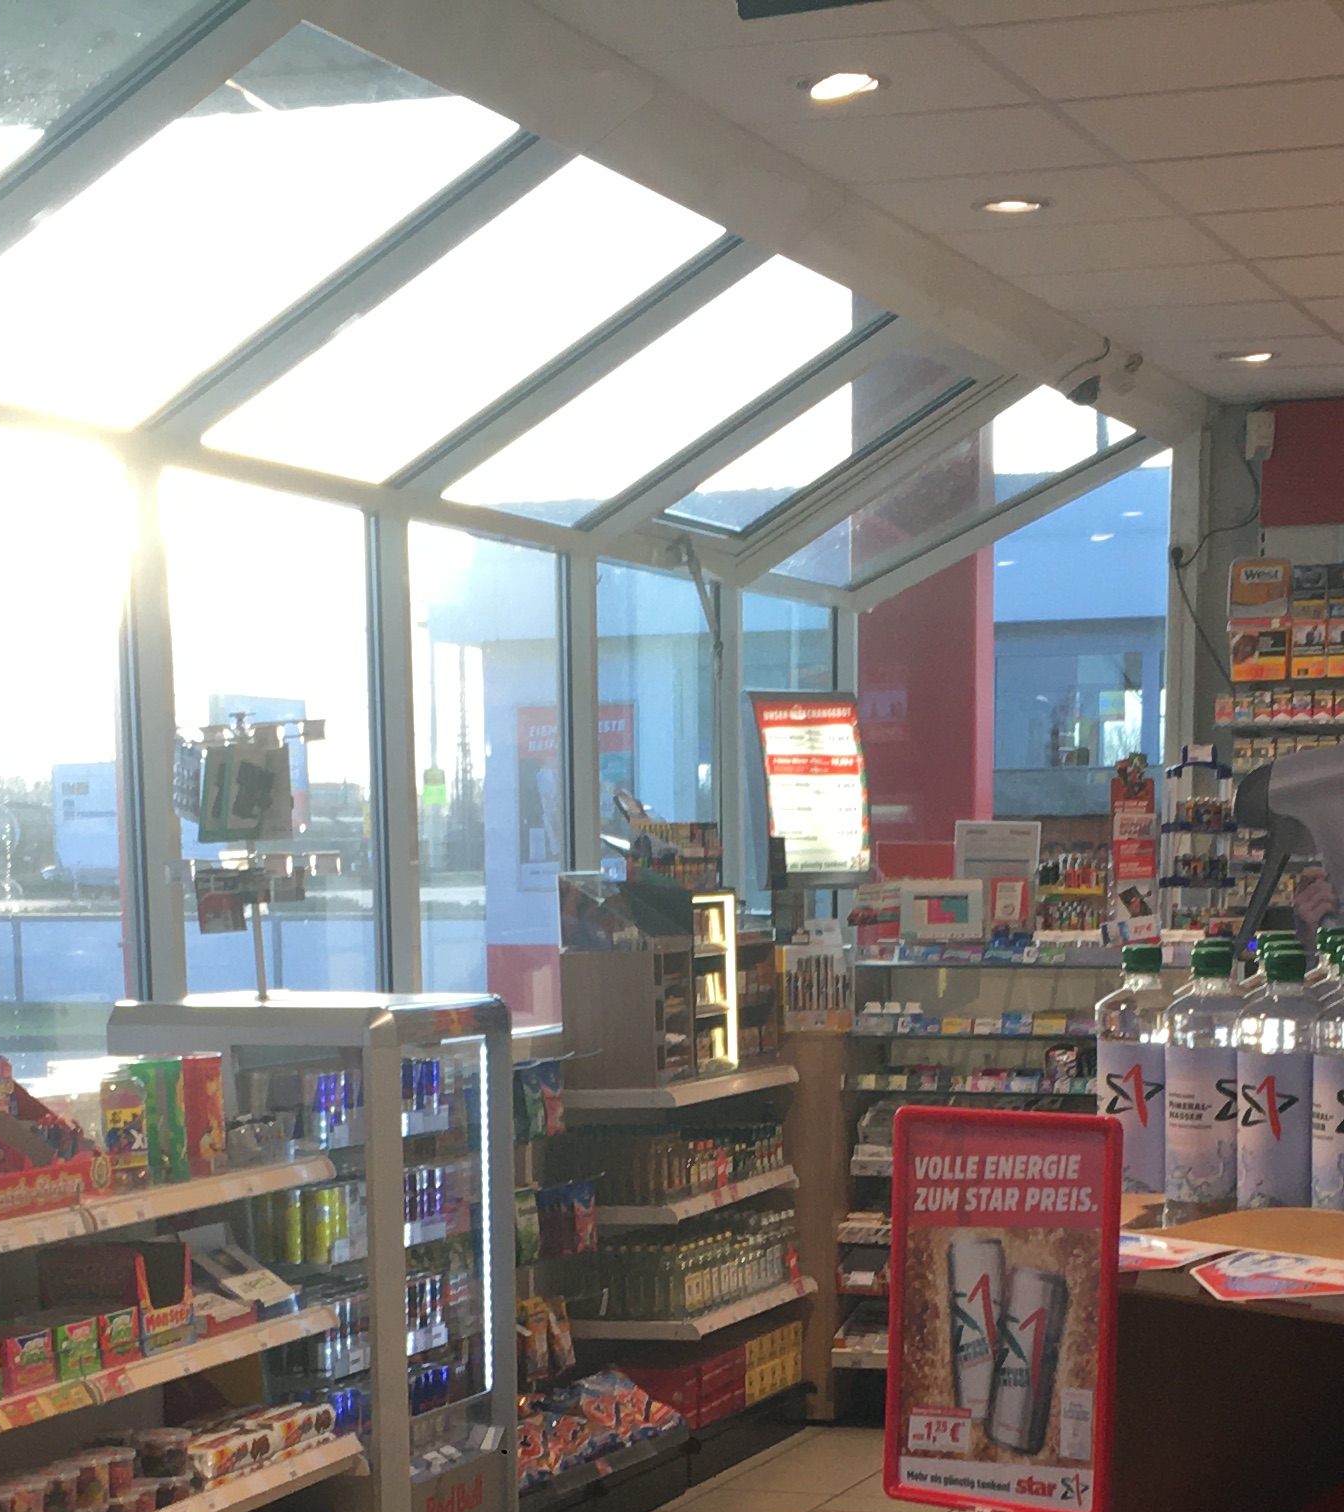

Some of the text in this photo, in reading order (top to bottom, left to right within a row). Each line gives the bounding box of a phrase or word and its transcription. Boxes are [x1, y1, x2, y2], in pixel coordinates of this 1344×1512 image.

[1244, 565, 1280, 580] West
[914, 1153, 1081, 1181] VOLLE ENERGIE
[914, 1186, 1099, 1213] ZUM STAR PREIS.
[906, 1469, 929, 1482] Mehr
[1015, 1474, 1057, 1497] star
